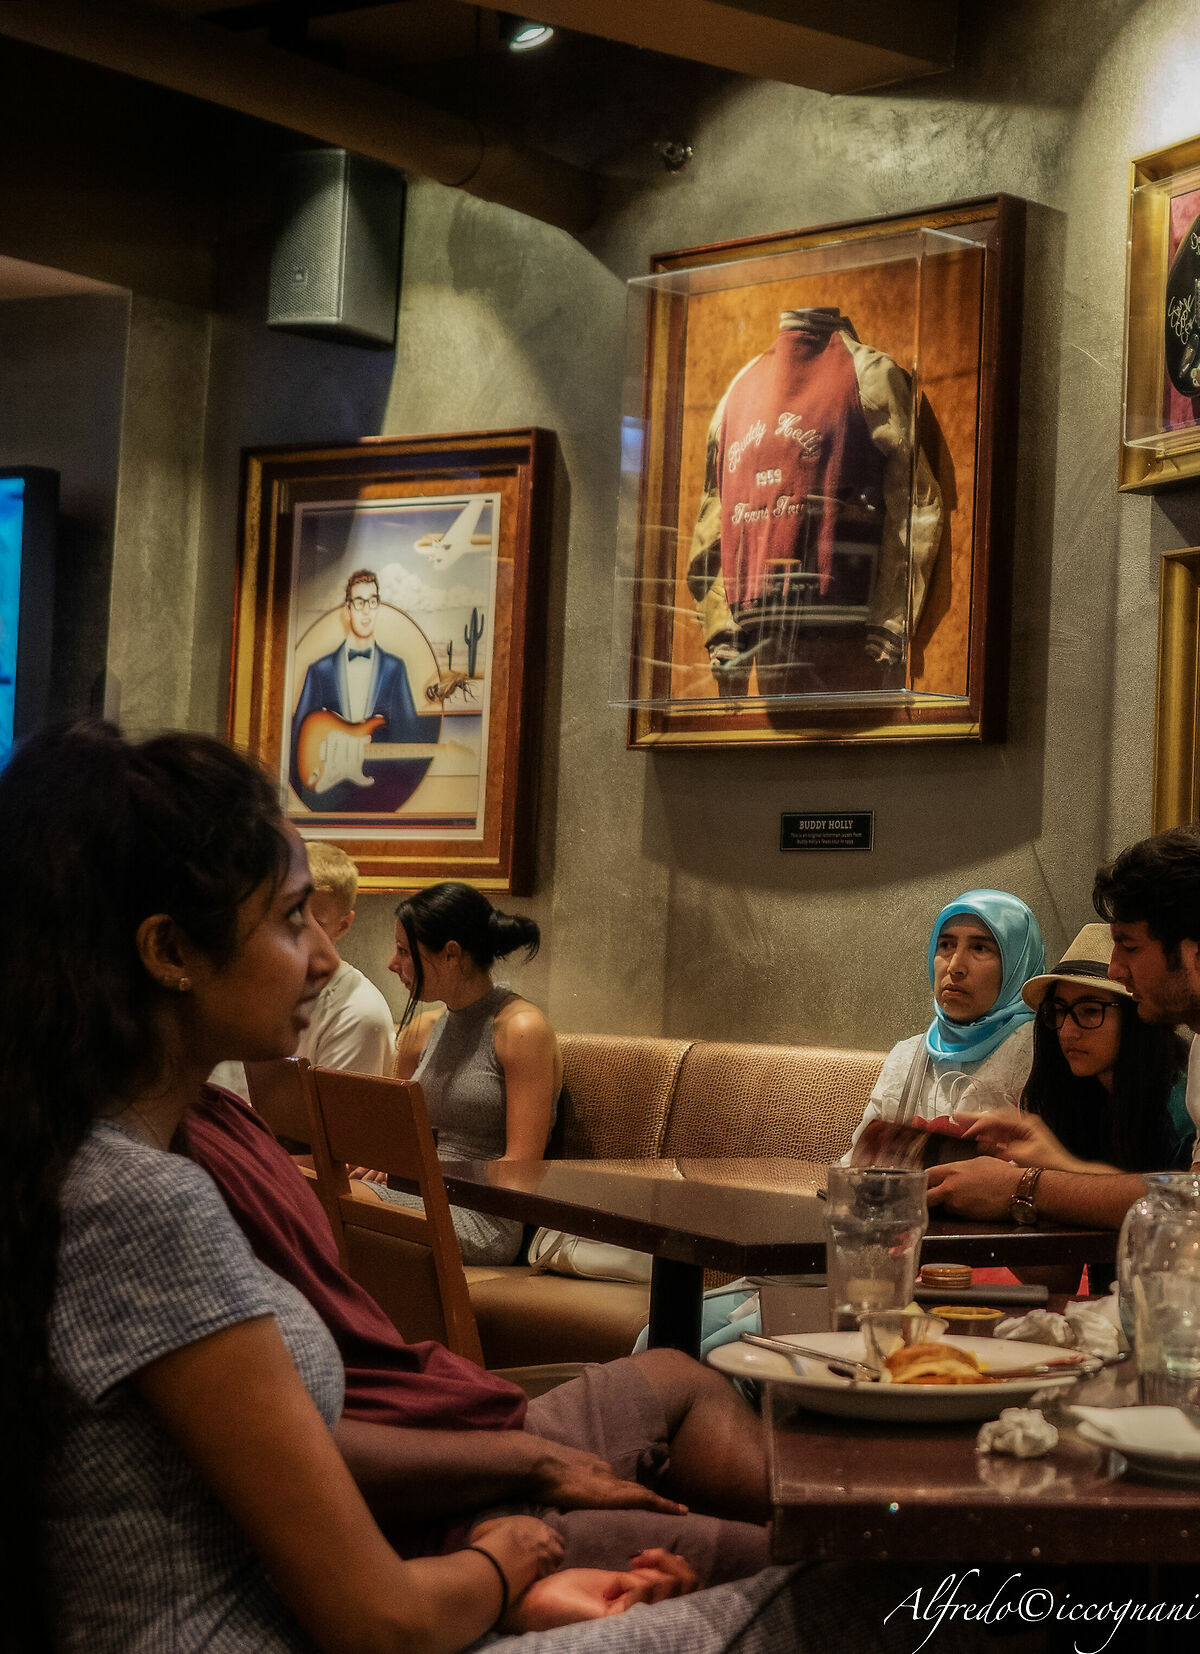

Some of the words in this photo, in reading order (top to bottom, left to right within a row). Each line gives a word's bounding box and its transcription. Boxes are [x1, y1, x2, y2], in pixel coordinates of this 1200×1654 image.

[728, 419, 767, 473] Buddy
[755, 468, 783, 487] 1959
[799, 820, 827, 830] BUDDY
[828, 820, 854, 830] HOLLY
